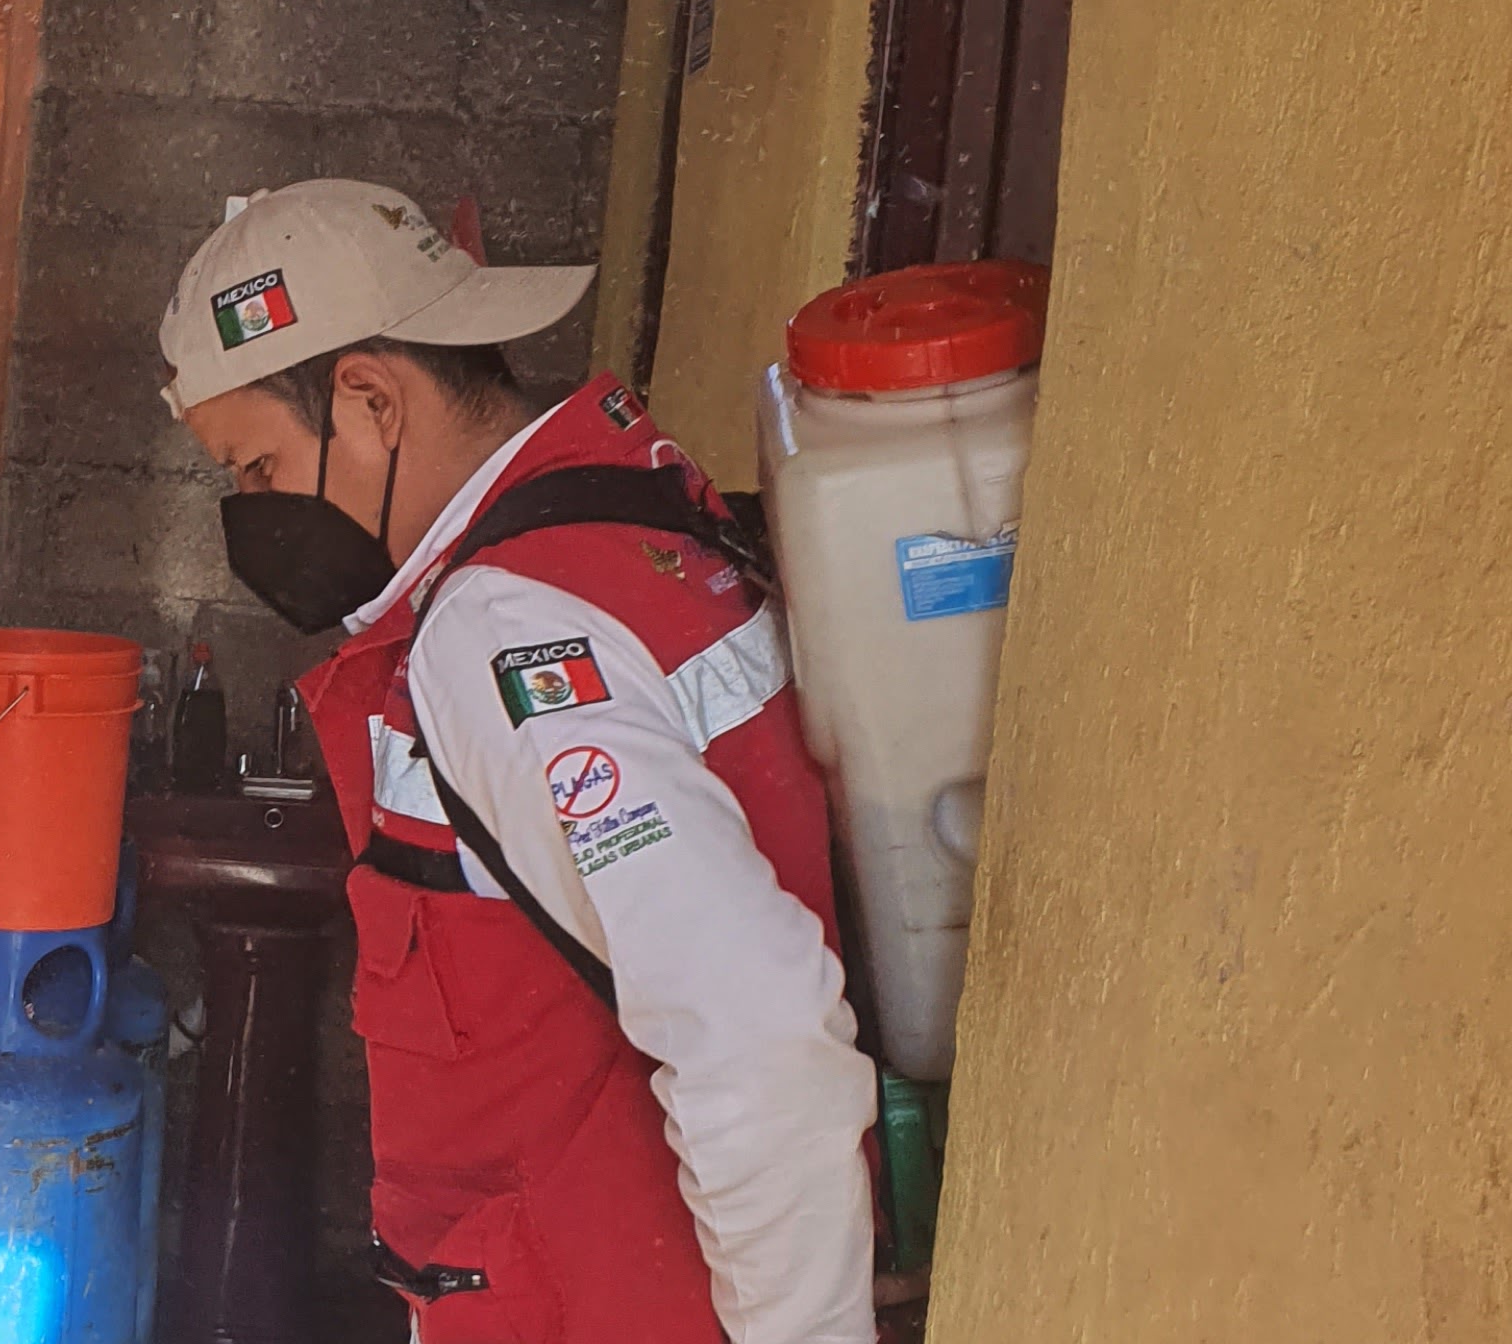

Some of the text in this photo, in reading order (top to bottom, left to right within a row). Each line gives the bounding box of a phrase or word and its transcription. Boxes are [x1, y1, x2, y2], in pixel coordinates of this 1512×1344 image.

[217, 273, 278, 309] MEXICO
[498, 642, 585, 674] MEXICO
[551, 763, 614, 802] PLAGAS
